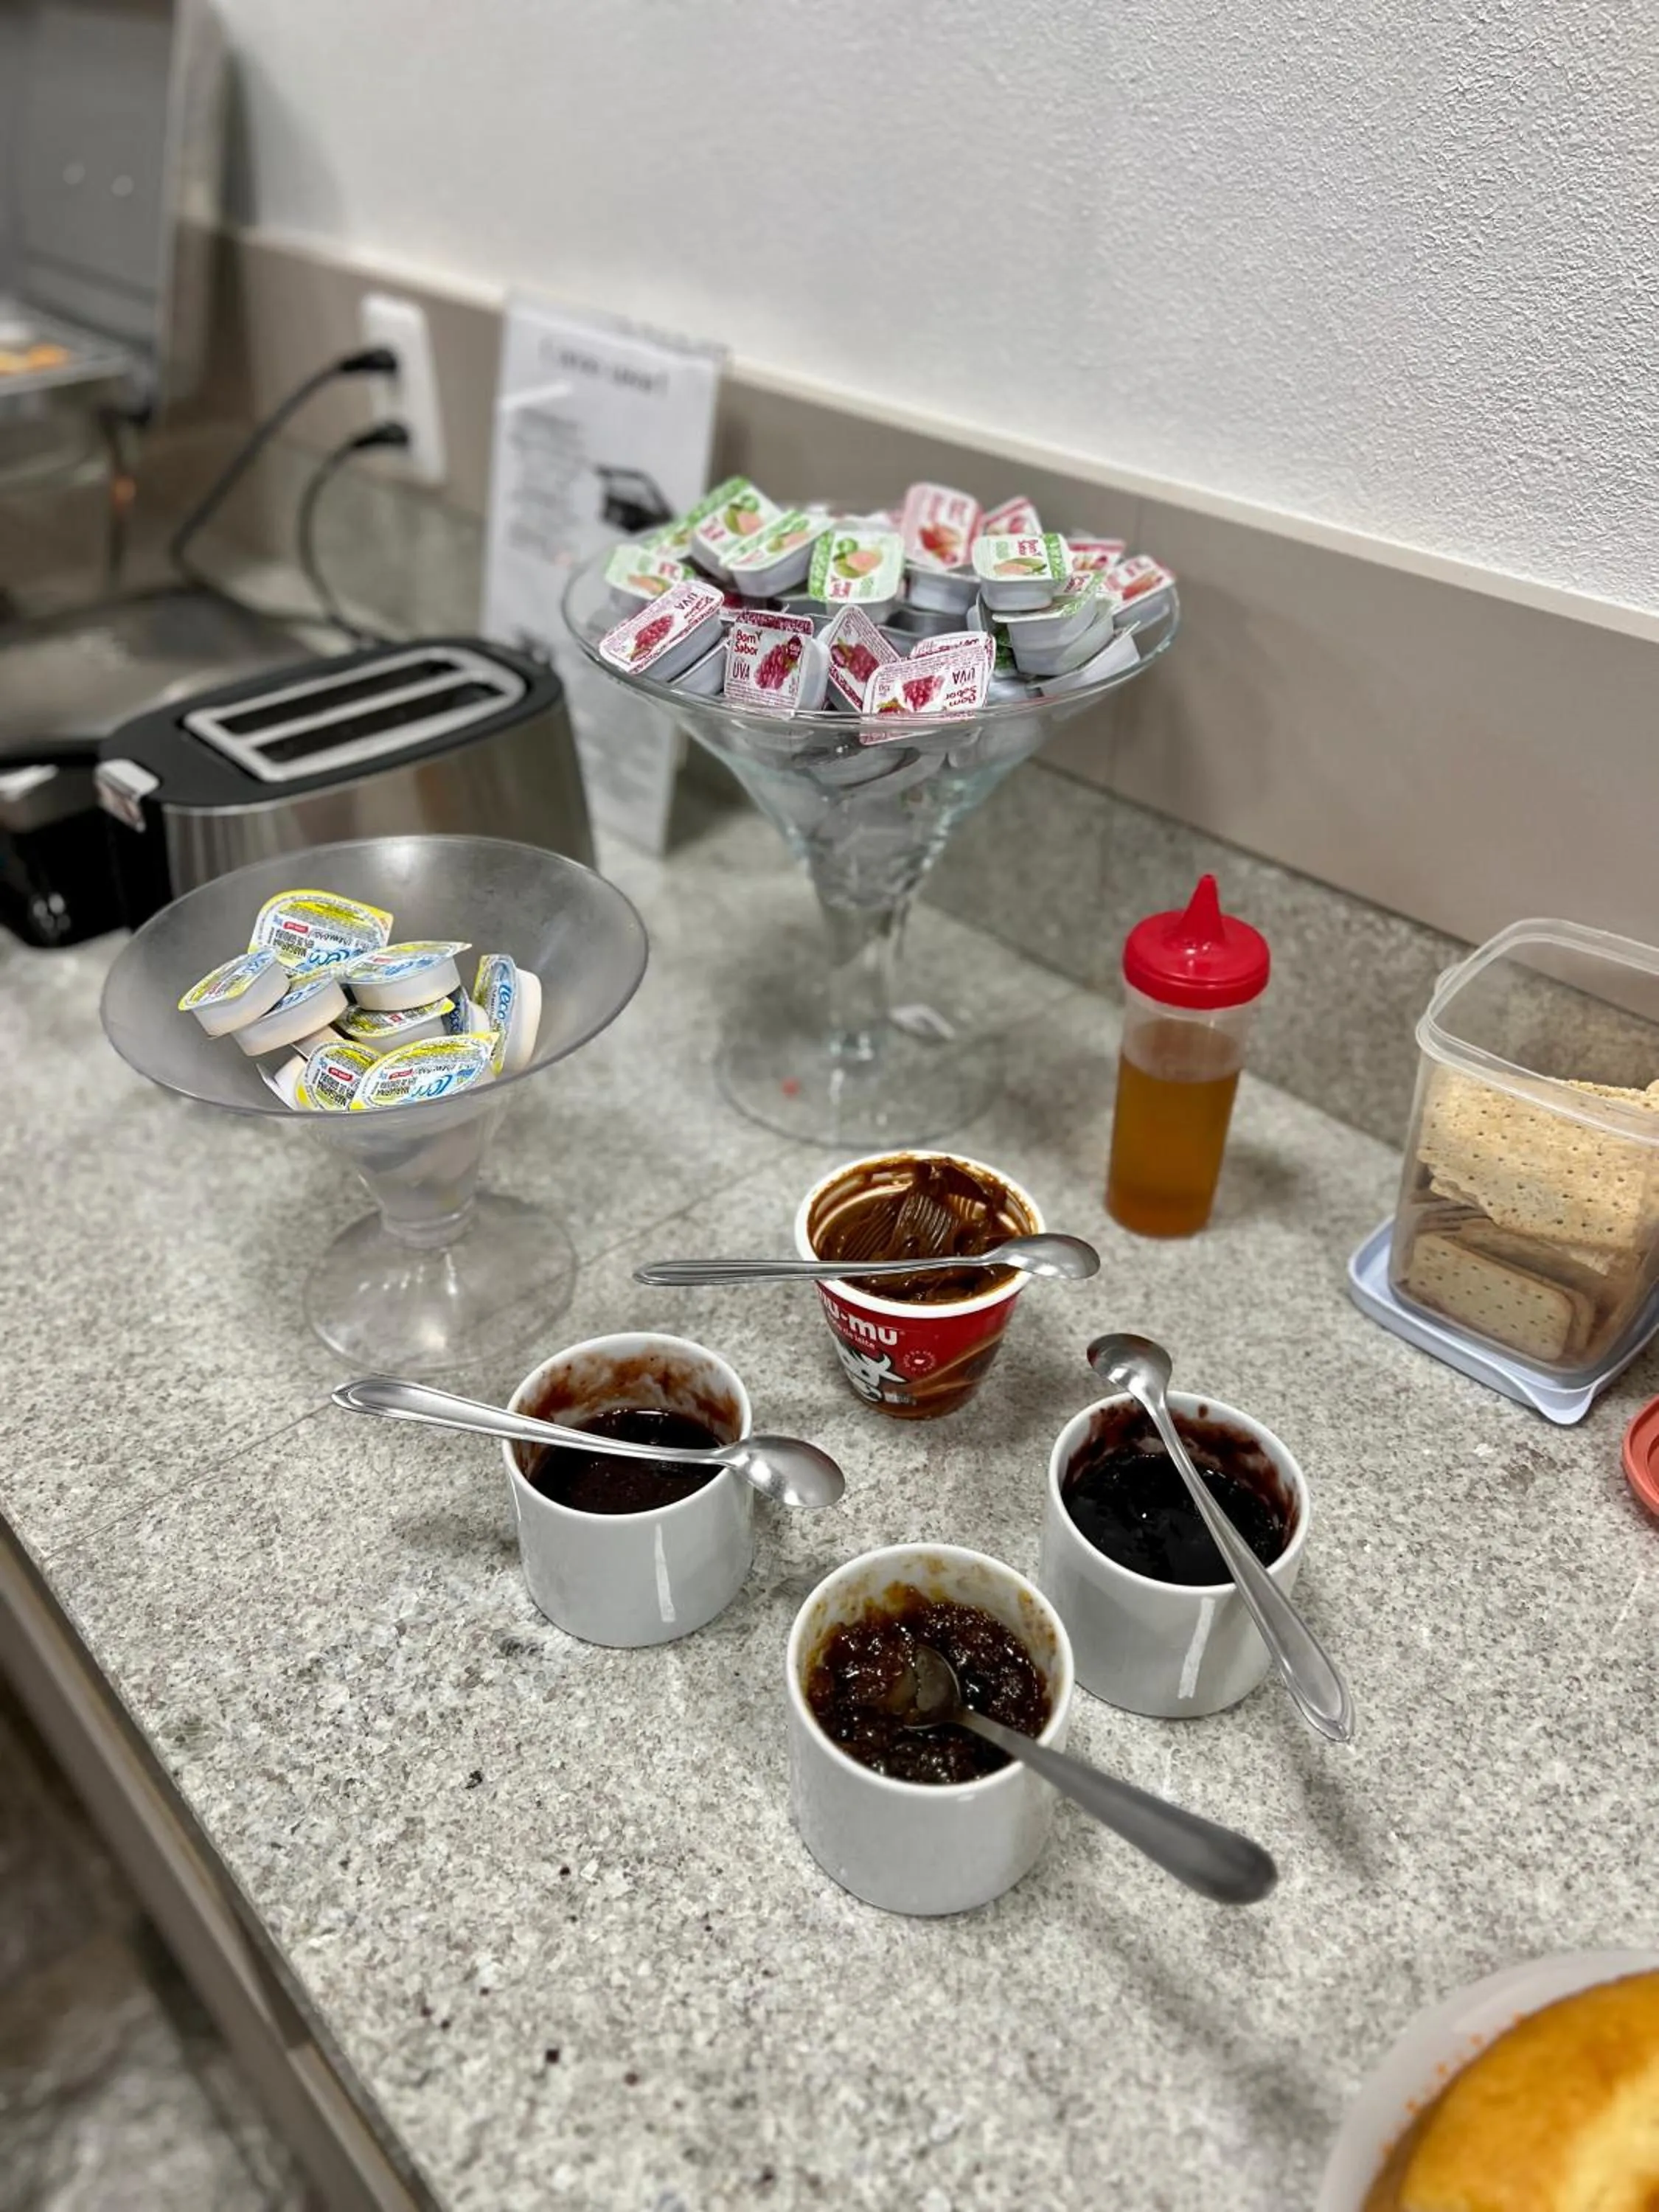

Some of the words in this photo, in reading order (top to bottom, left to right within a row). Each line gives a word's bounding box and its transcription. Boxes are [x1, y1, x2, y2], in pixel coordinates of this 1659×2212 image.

[674, 592, 698, 610] UVA
[736, 629, 756, 644] Bom
[732, 662, 750, 679] UVA
[952, 667, 975, 685] UVA
